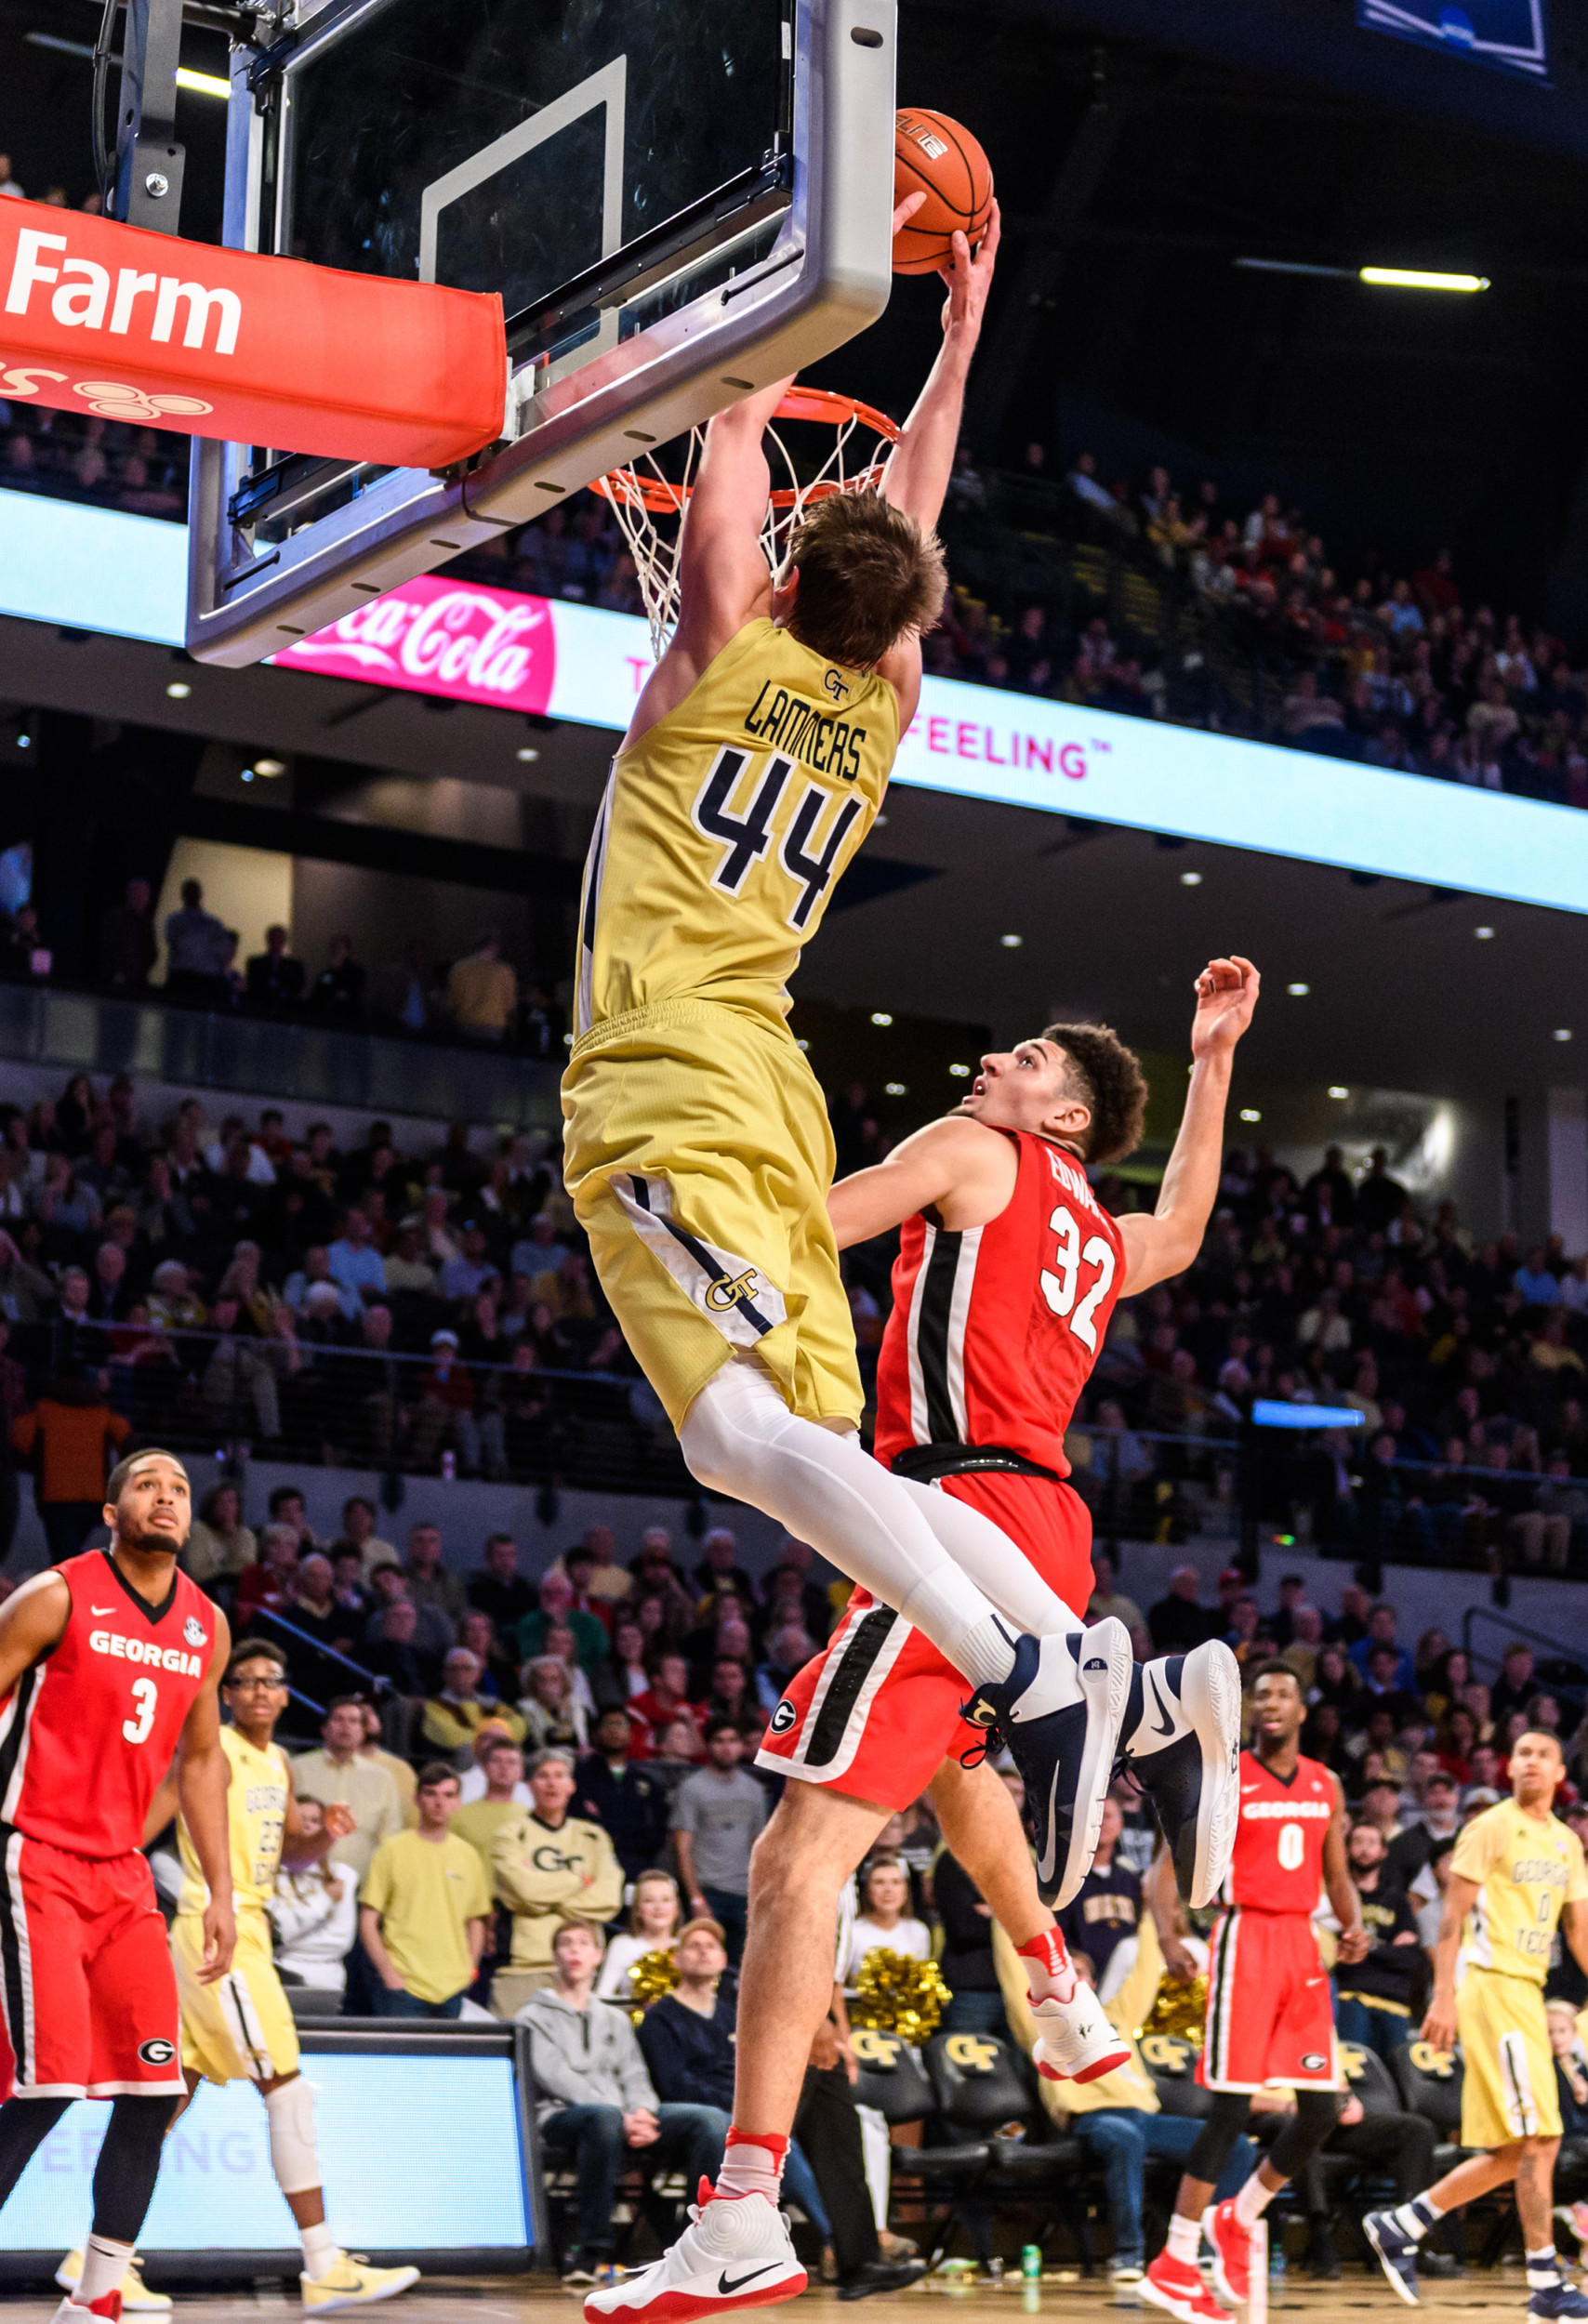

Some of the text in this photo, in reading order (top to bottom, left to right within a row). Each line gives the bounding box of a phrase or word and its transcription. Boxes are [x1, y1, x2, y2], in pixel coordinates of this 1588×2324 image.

[5, 228, 242, 355] Farm
[290, 591, 549, 693] ca-Cola
[744, 680, 867, 781] LAMMERS
[690, 742, 868, 934] 44
[705, 1268, 759, 1312] GT
[1040, 1205, 1116, 1356] 32
[89, 1630, 202, 1679] GEORGIA
[122, 1677, 158, 1744] 3
[771, 1700, 796, 1733] G
[1242, 1801, 1330, 1819] GEORGIA
[1277, 1823, 1304, 1870] 0
[141, 2039, 176, 2065] G
